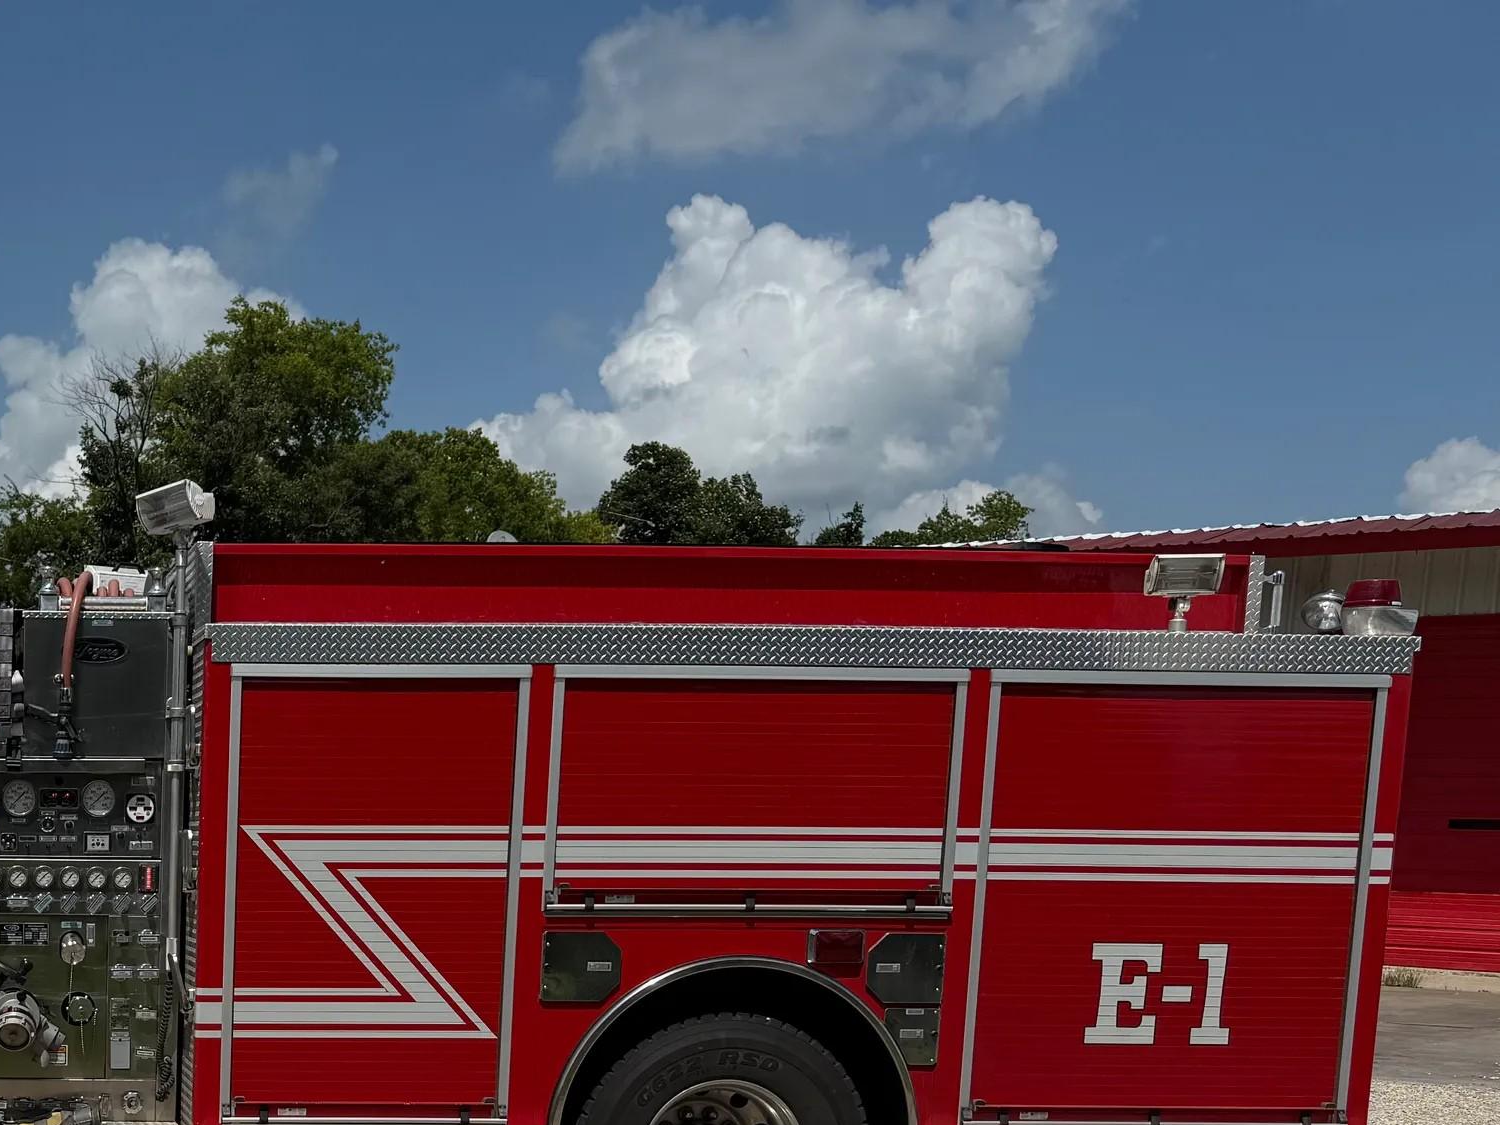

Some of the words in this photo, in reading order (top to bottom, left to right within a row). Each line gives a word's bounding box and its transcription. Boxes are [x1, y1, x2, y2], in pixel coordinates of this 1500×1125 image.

[1084, 943, 1230, 1045] E-1
[636, 1056, 703, 1107] G622
[718, 1051, 780, 1071] RSD
